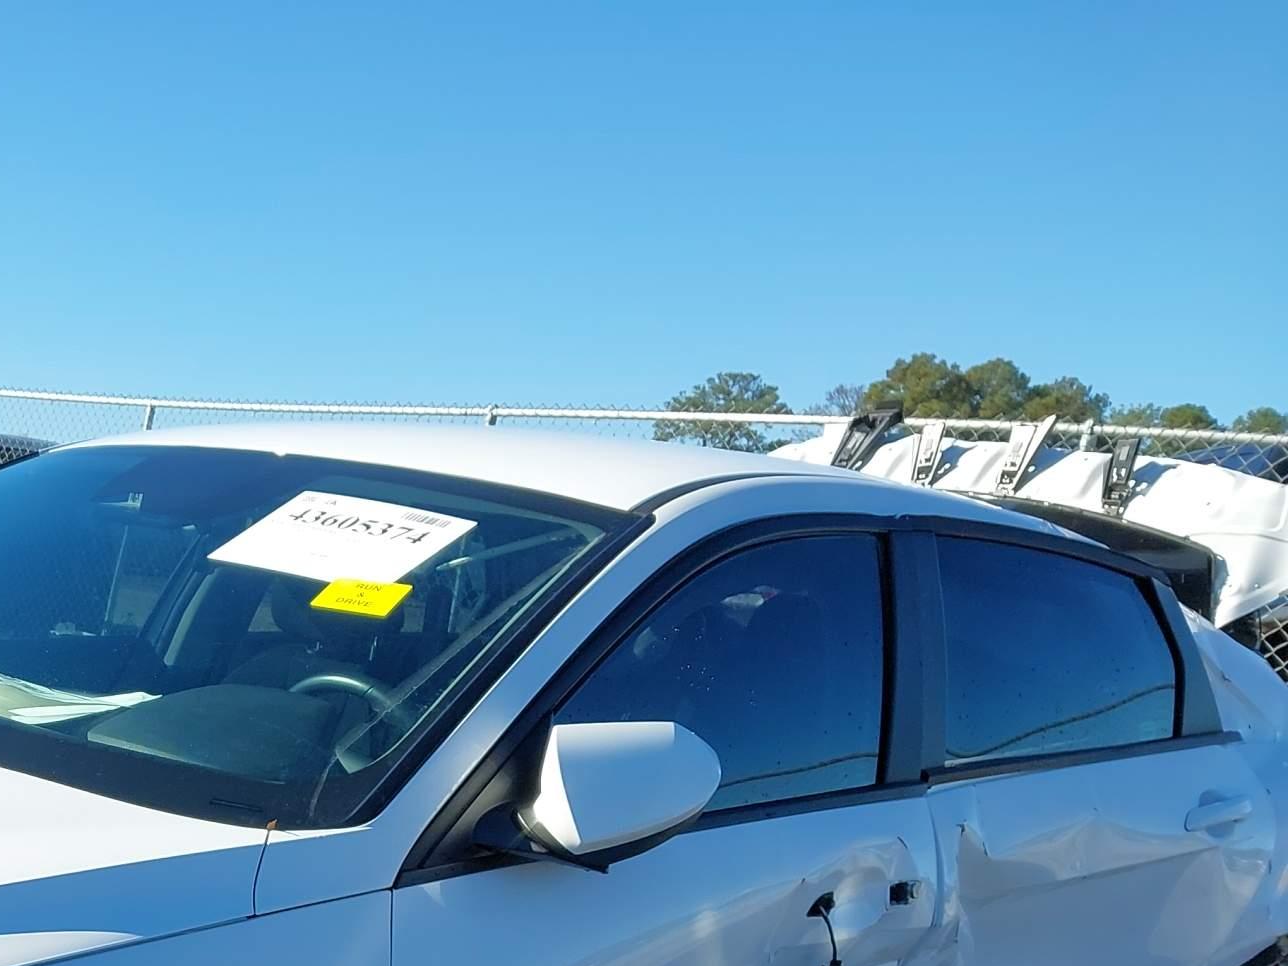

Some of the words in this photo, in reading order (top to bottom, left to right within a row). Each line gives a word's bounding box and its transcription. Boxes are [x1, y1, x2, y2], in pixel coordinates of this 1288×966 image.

[289, 508, 431, 544] 43605374
[355, 583, 384, 592] RUN
[335, 597, 374, 607] DRIVE
